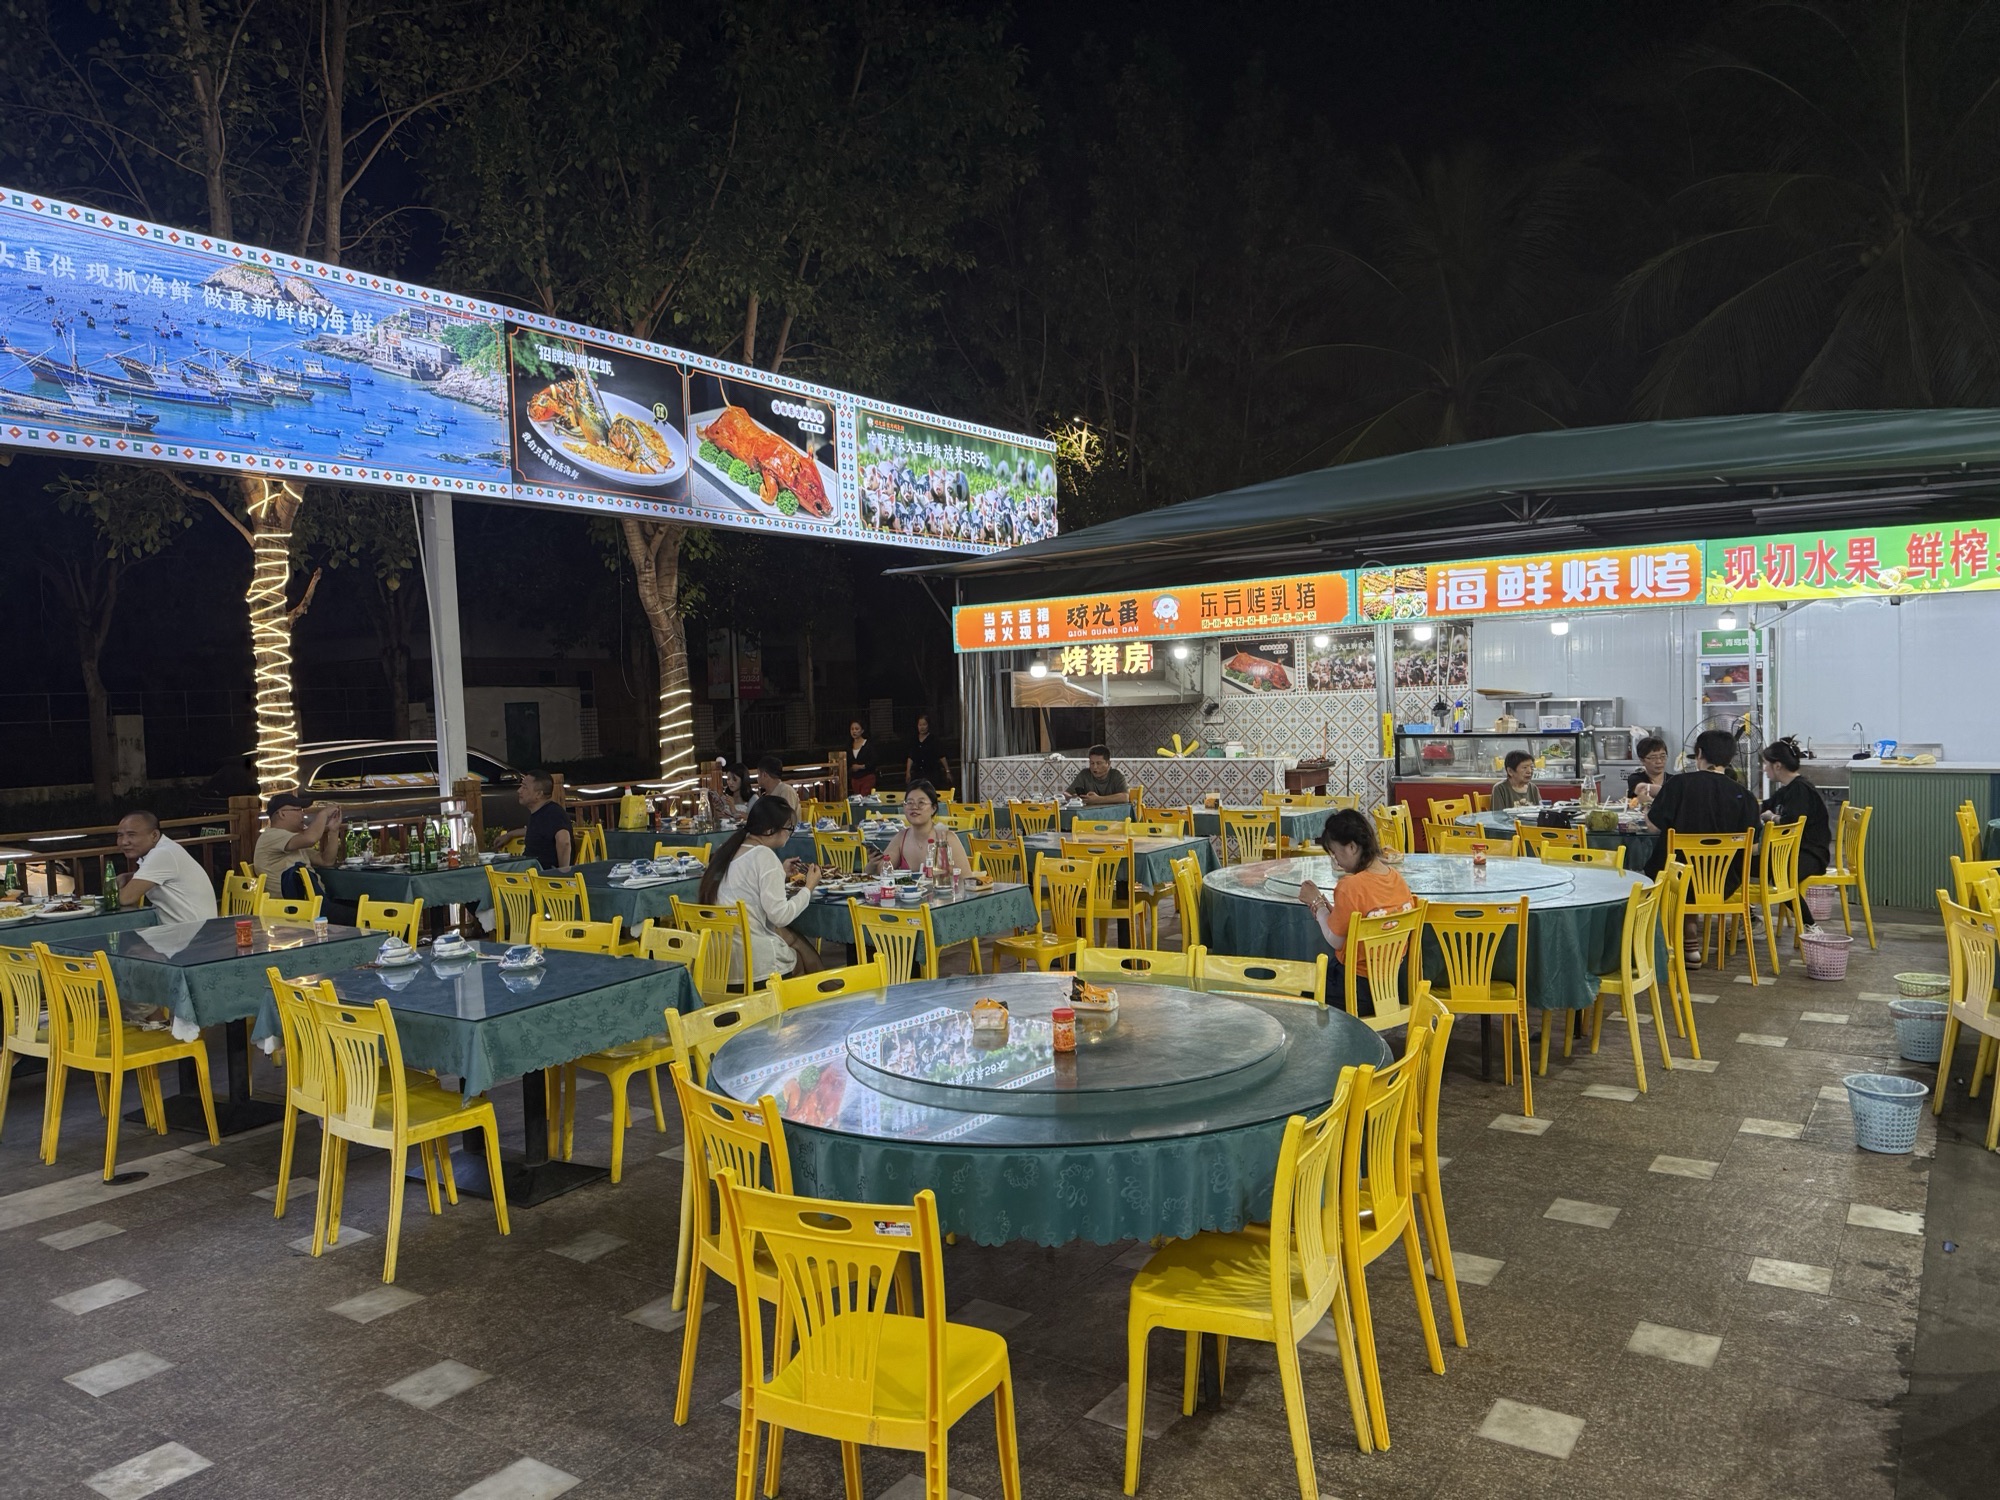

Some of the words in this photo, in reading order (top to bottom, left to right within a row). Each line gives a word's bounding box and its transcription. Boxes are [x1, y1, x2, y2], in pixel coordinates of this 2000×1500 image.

[85, 262, 193, 304] 现抓海鲜
[201, 284, 377, 342] 做最新鲜的海鲜
[538, 344, 613, 376] 招牌澳洲龙虾
[942, 443, 987, 468] 放养58天
[1723, 536, 1882, 590] 现切水果
[1905, 526, 2000, 581] 鲜榨
[1436, 551, 1691, 611] 海鲜烧烤
[983, 607, 1050, 627] 当天活猪
[1200, 582, 1316, 617] 东方烤乳猪
[1091, 627, 1118, 636] GUANG
[1122, 625, 1139, 634] DAN
[1061, 642, 1152, 677] 烤猪房
